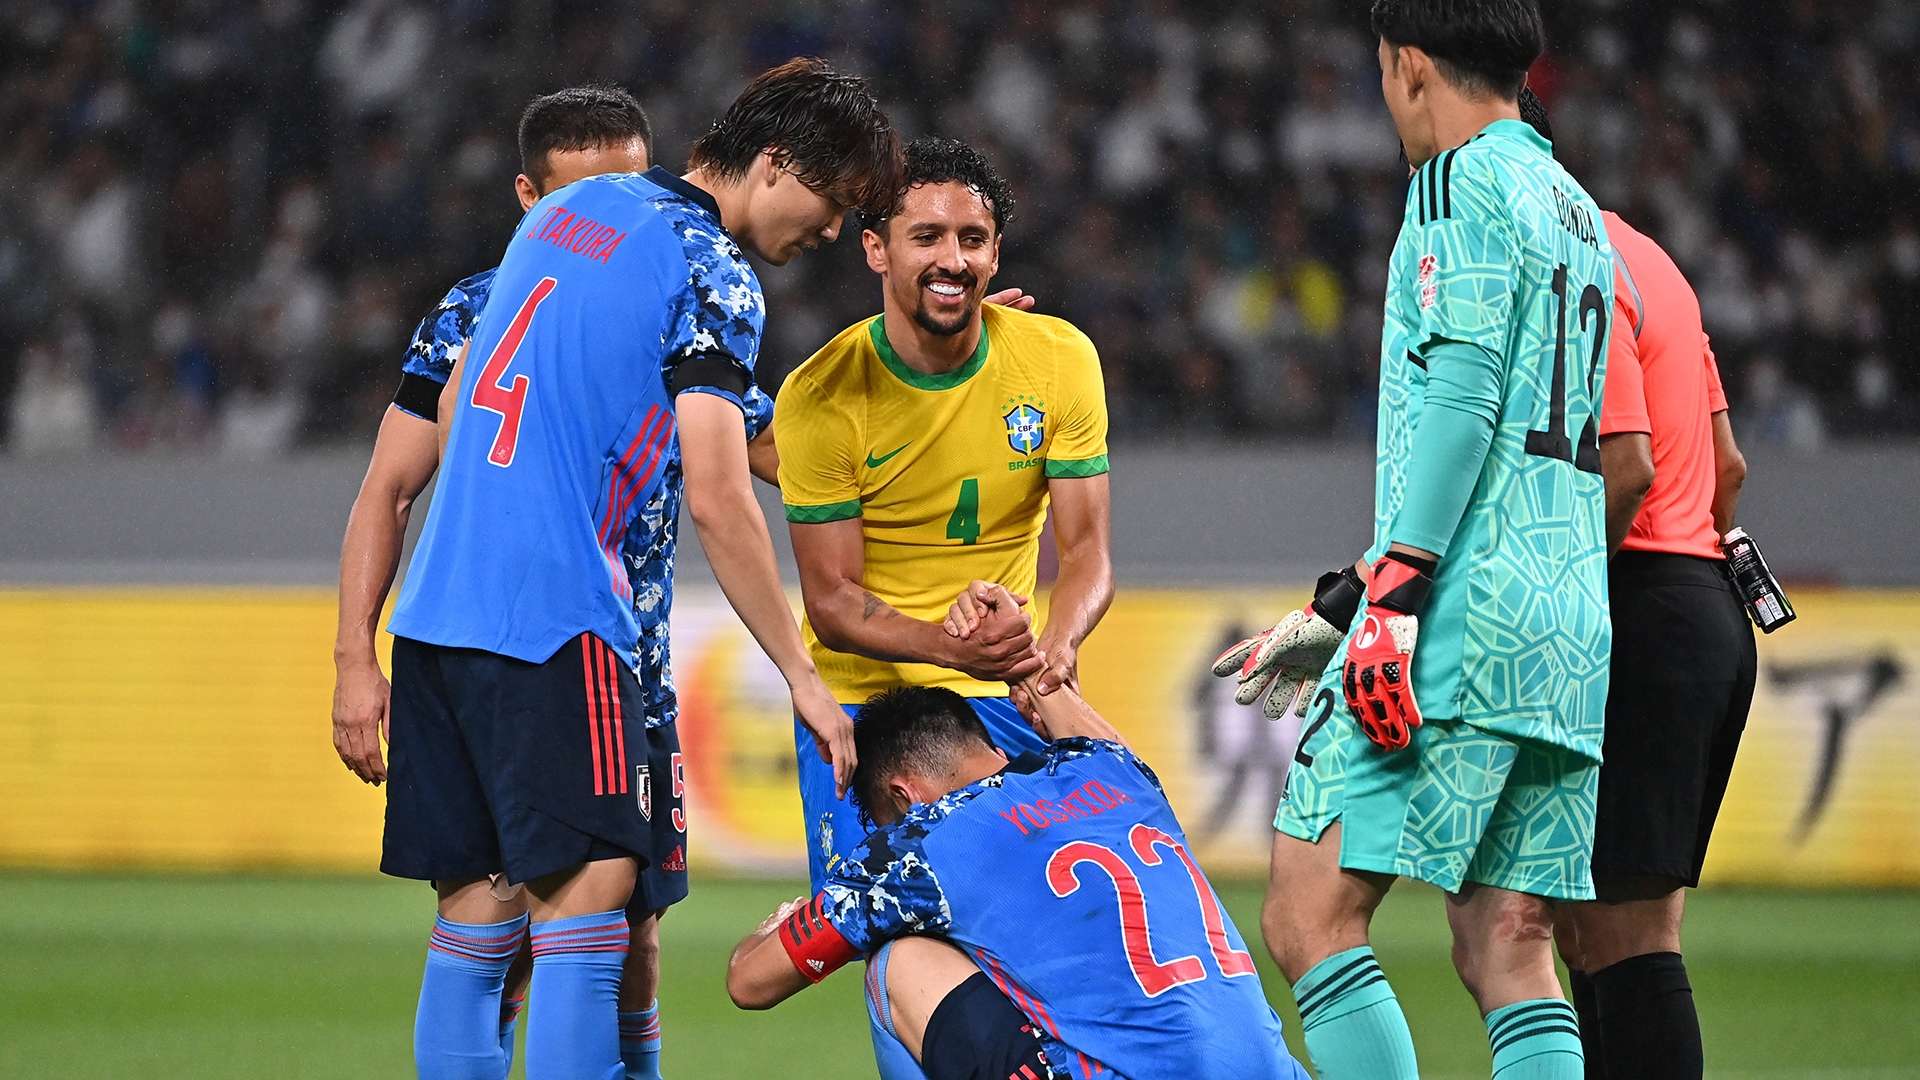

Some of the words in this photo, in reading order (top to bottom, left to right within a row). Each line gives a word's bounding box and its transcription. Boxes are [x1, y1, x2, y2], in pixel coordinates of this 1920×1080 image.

[527, 206, 627, 265] ITAKURA
[1552, 185, 1599, 251] GONDA
[471, 276, 558, 468] 4
[1524, 262, 1606, 476] 12
[1017, 424, 1033, 433] CBF
[1008, 457, 1044, 472] BRASI
[946, 478, 981, 545] 4
[1294, 687, 1336, 768] 2
[671, 752, 687, 833] 5
[1000, 780, 1134, 835] YOSHIDA
[1046, 823, 1256, 998] 22
